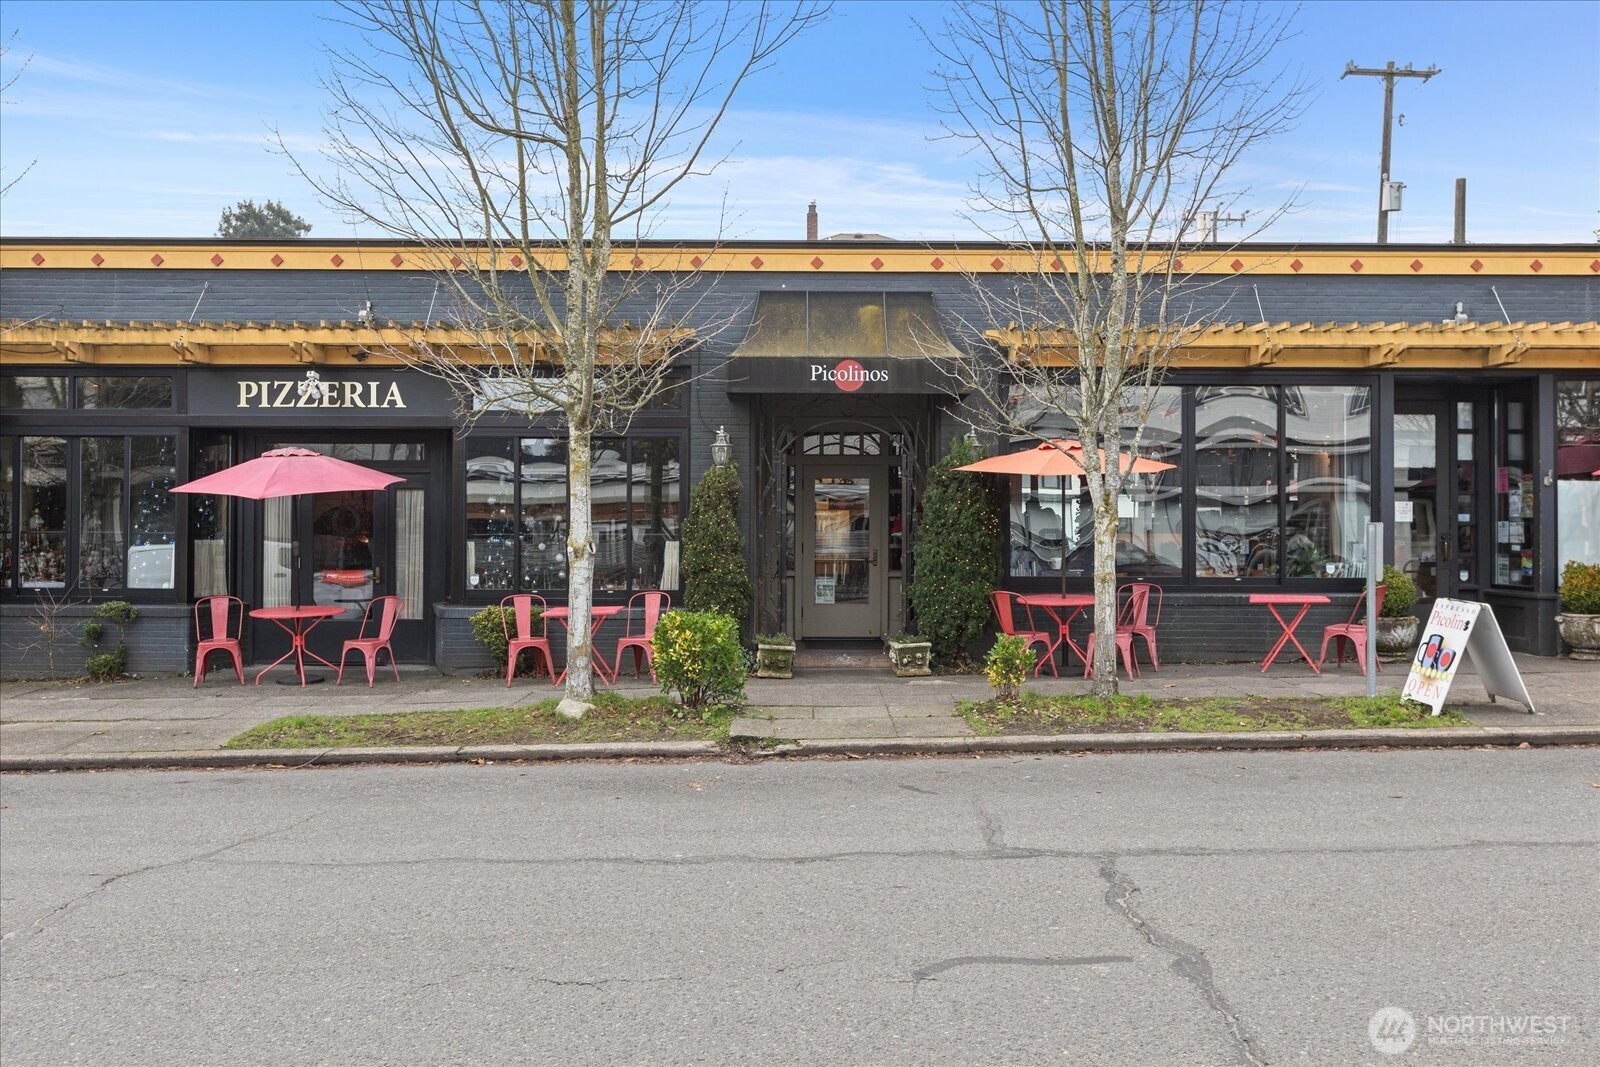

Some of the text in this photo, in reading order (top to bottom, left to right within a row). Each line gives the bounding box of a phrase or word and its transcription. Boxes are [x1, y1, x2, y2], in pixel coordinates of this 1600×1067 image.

[810, 364, 889, 382] Picolinos
[236, 380, 407, 409] PIZZERIA
[1408, 679, 1443, 699] OPEN
